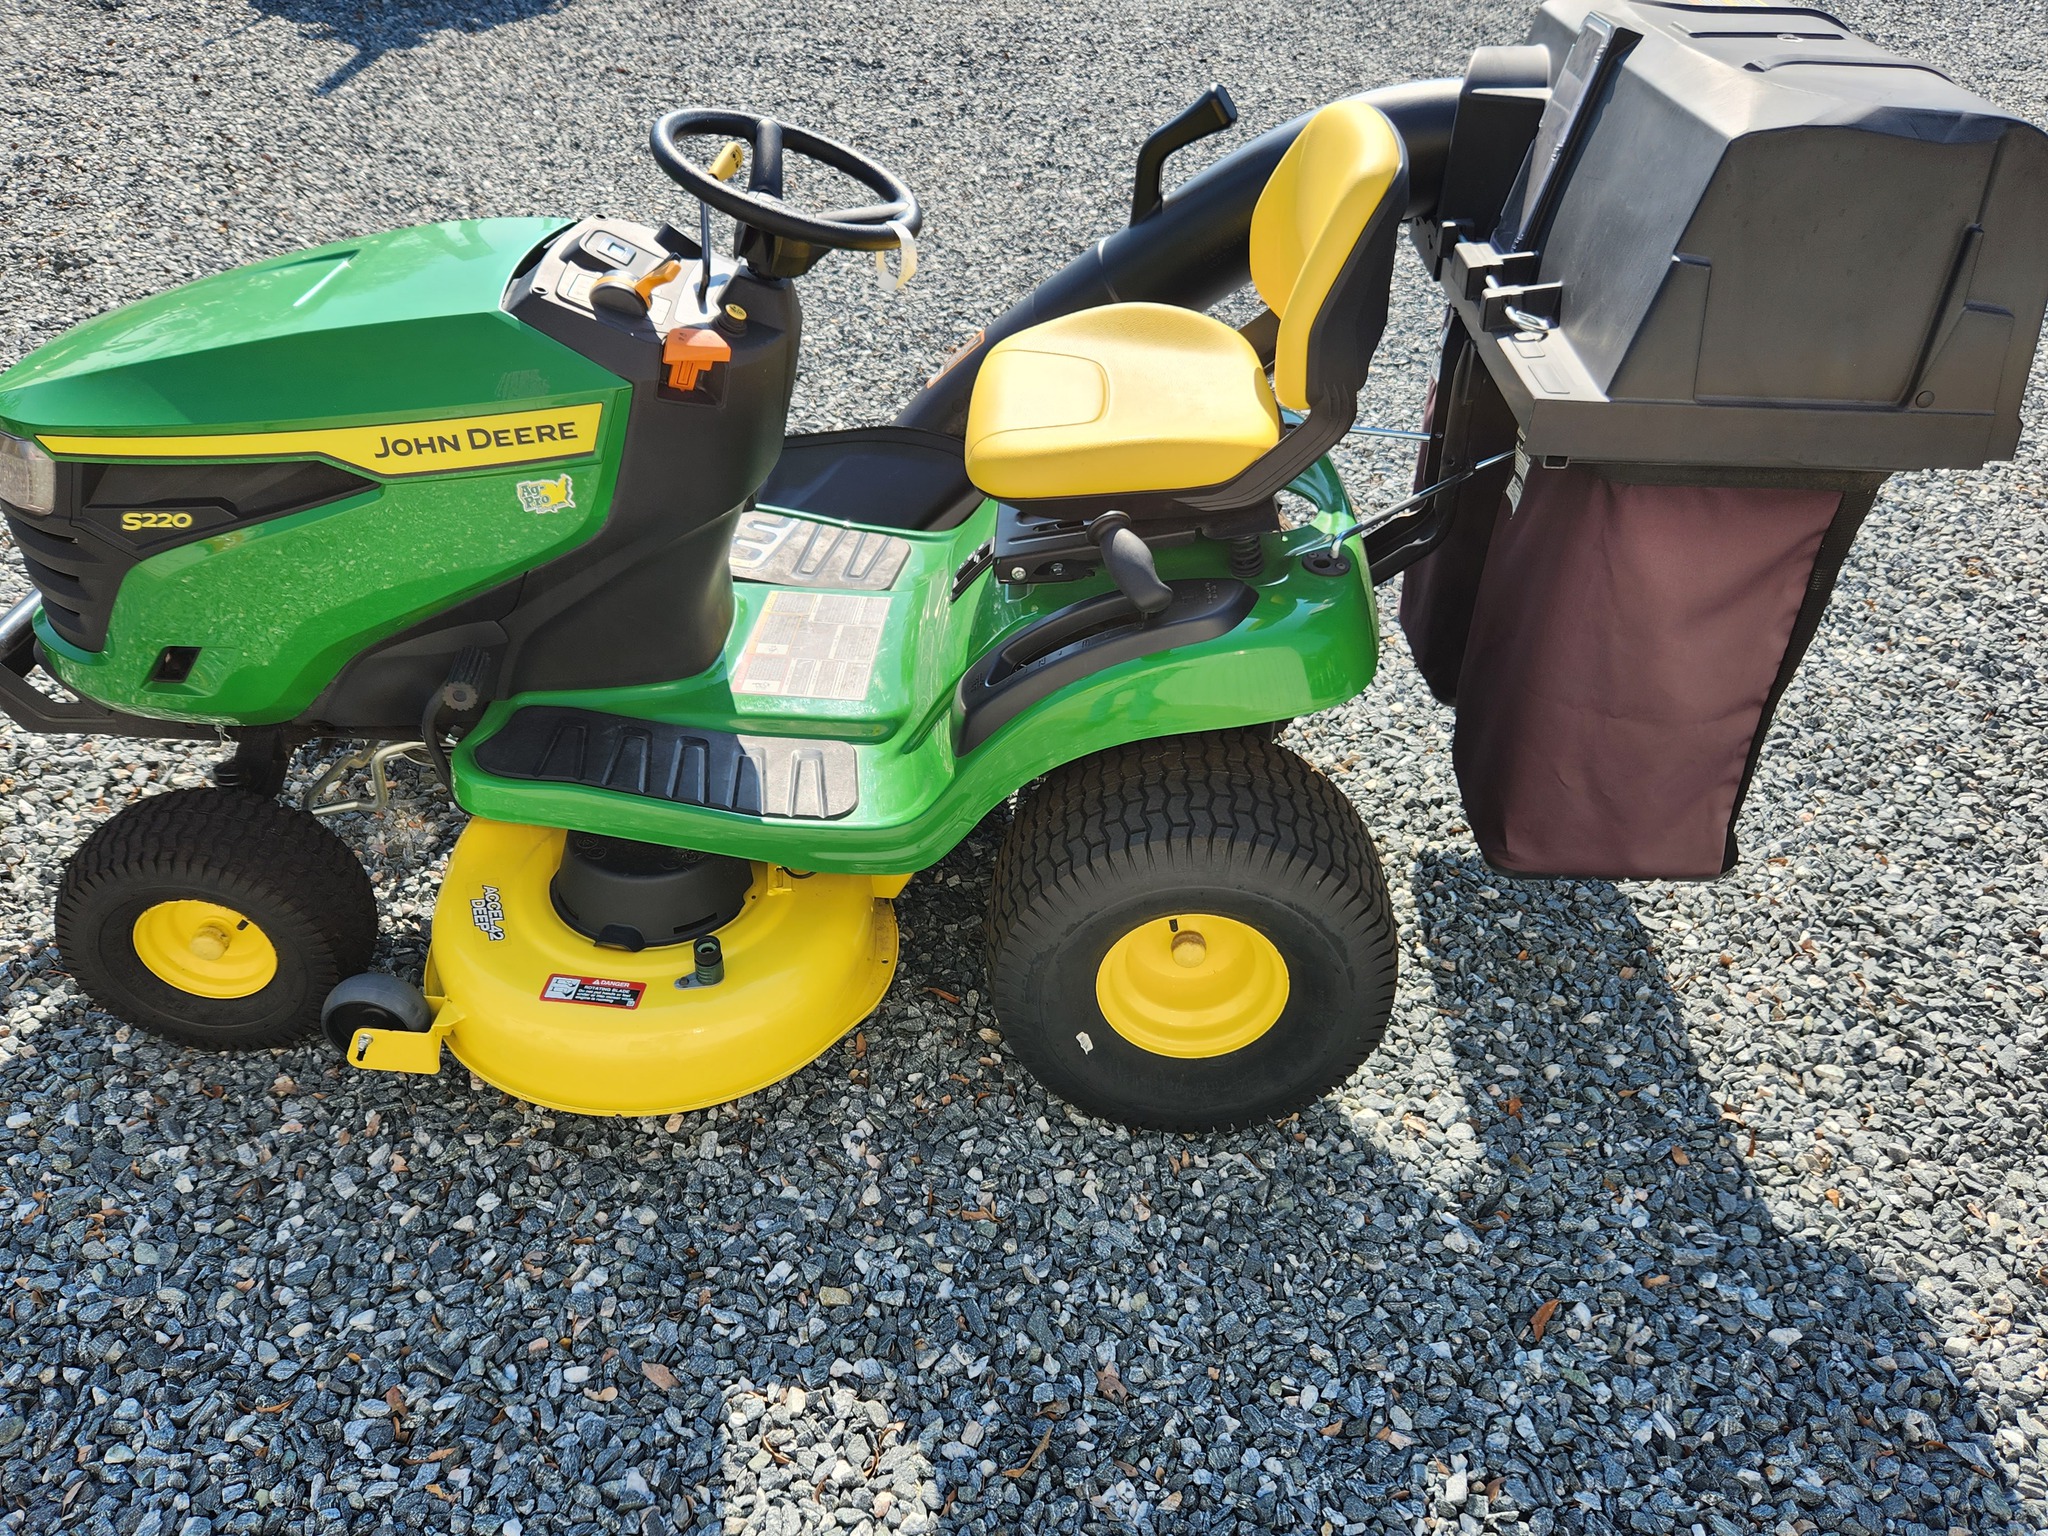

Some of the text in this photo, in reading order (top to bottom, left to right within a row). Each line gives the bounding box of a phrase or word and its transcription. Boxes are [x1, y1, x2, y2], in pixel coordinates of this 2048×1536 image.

[375, 422, 578, 458] JOHN DEERE
[524, 495, 550, 508] Pro
[121, 511, 193, 531] S220
[470, 898, 491, 932] DEEP
